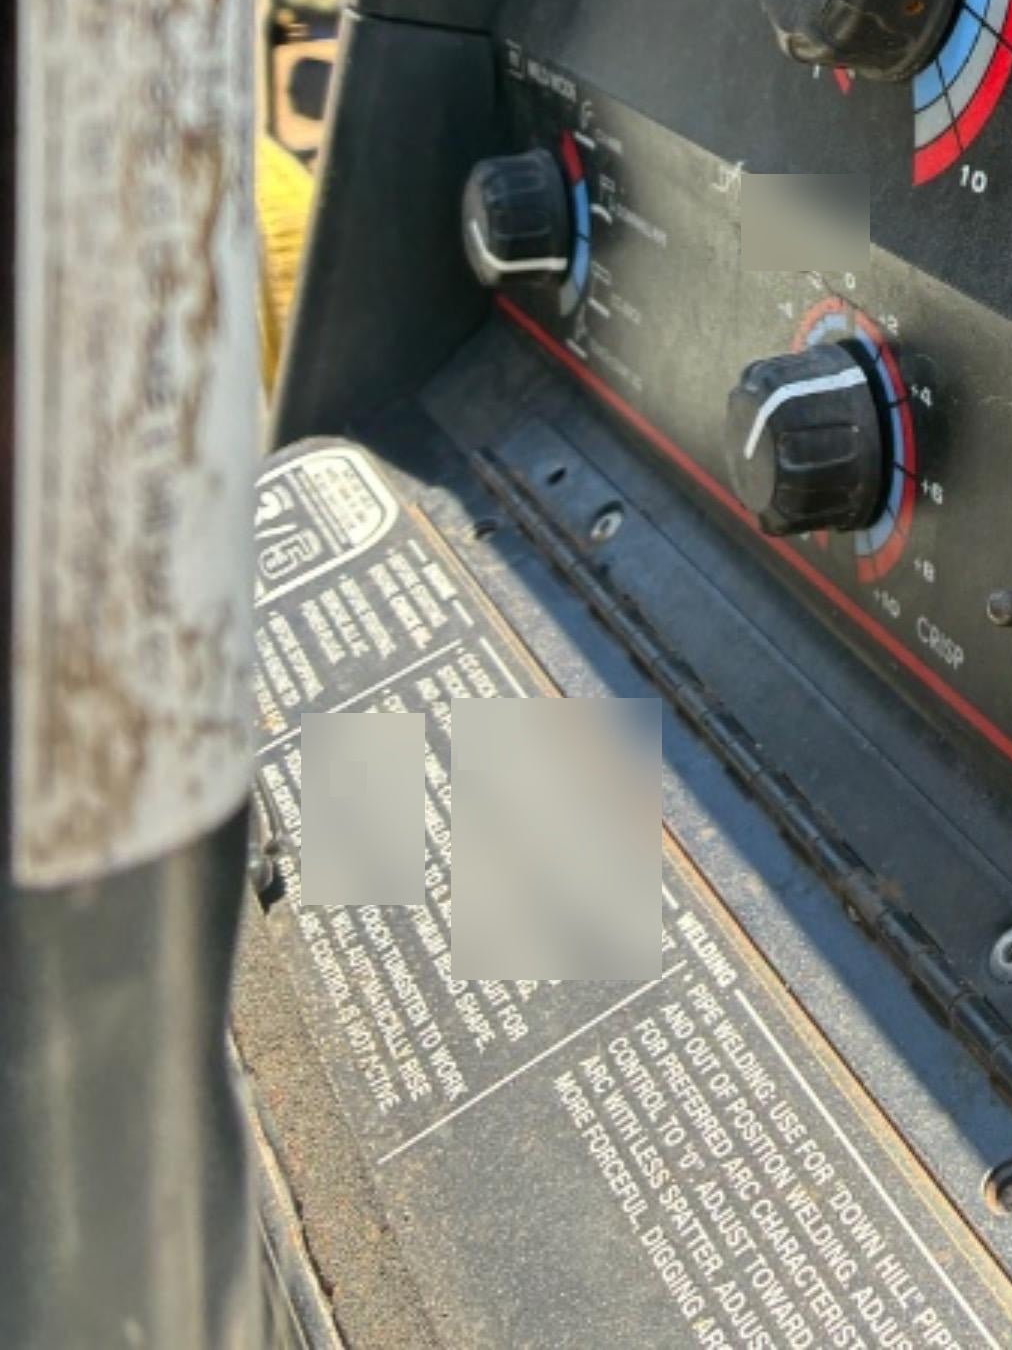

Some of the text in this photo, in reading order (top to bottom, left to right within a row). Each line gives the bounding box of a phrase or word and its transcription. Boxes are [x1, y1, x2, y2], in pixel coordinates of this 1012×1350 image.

[959, 164, 988, 193] 10
[916, 616, 966, 671] CRISP
[676, 911, 737, 988] WELDING
[418, 1021, 443, 1049] TO
[429, 1044, 468, 1102] WORK
[497, 1004, 529, 1042] FOR
[686, 983, 725, 1026] PIPE
[713, 1019, 776, 1106] WELDING:
[769, 1100, 807, 1145] USE
[794, 1138, 835, 1186] FOR
[578, 1055, 616, 1094] ARC
[602, 1088, 643, 1141] WITH
[629, 1136, 675, 1190] LESS
[658, 1184, 724, 1283] SPATTER.
[634, 1017, 669, 1057] FOR
[655, 1052, 734, 1159] PREFERRED
[719, 1157, 762, 1201] ARC
[660, 1002, 695, 1039] AND
[684, 1036, 721, 1075] OUT
[708, 1072, 739, 1099] OF
[724, 1097, 797, 1190] POSITION
[785, 1182, 858, 1290] WELDING.
[553, 1070, 596, 1129] MORE
[581, 1121, 648, 1234] FORCEFUL,
[639, 1224, 705, 1321] DIGGING
[607, 1036, 668, 1123] CONTROL
[656, 1114, 686, 1147] TO
[693, 1180, 758, 1258] ADJUST
[743, 1253, 814, 1350] TOWARD
